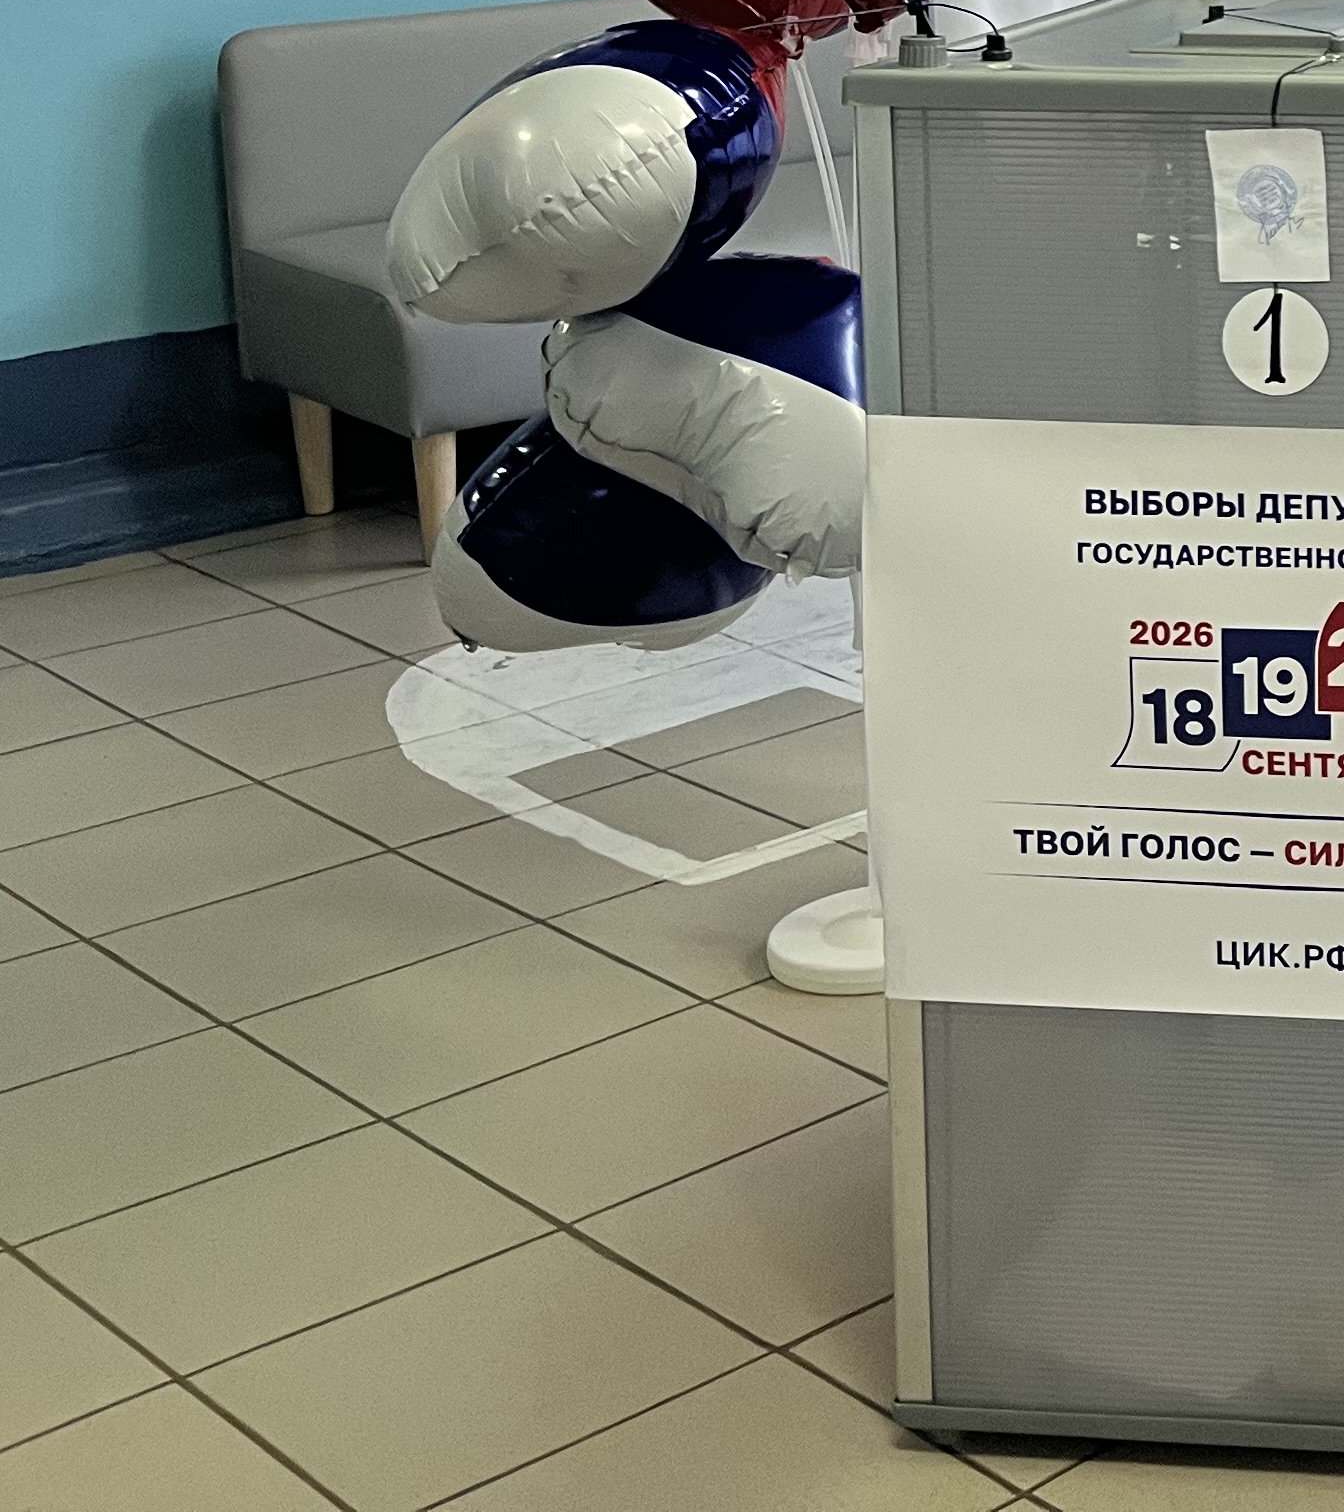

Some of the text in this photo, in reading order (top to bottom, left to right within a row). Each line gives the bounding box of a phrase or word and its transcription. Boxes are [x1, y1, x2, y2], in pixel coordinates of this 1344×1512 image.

[1253, 293, 1286, 384] 1
[1085, 489, 1245, 518] ВЫБОРЫ
[1129, 620, 1214, 647] 2026
[1142, 688, 1217, 746] 18
[1232, 656, 1309, 717] 19
[1013, 825, 1110, 857] ТВОЙ
[1121, 832, 1240, 862] ГОЛОС
